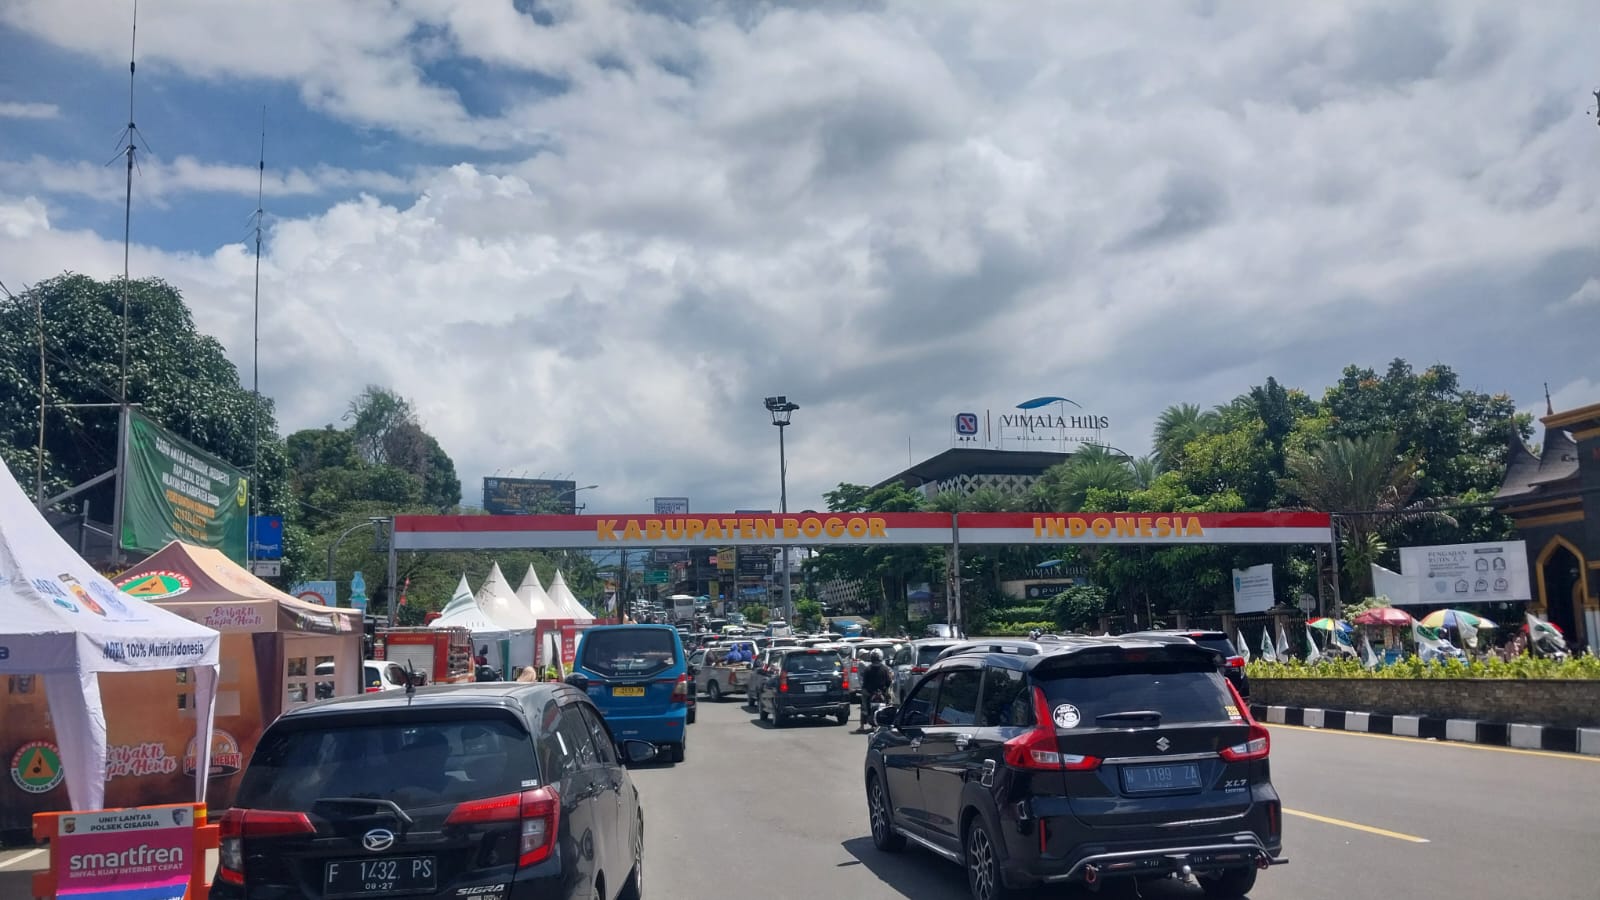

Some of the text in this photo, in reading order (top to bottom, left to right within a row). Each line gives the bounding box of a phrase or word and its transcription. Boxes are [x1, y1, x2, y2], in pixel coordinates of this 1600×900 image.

[1002, 414, 1109, 433] VIMALA HILLS
[596, 516, 888, 541] KABUPATEN BOGOR
[1032, 516, 1205, 538] INDONESIA
[126, 643, 147, 657] 100%
[148, 641, 170, 657] Murni
[169, 640, 204, 656] Indonesia
[106, 744, 162, 763] erbakti
[1224, 779, 1247, 787] XL7
[90, 821, 160, 831] POLSEK CISARUA
[119, 814, 152, 822] LANTAS
[69, 844, 183, 870] smartfren
[69, 862, 184, 878] SINYAL KUAT INTERNET CEPAT
[328, 859, 432, 883] F 1432 PS
[456, 884, 505, 896] SIGRA
